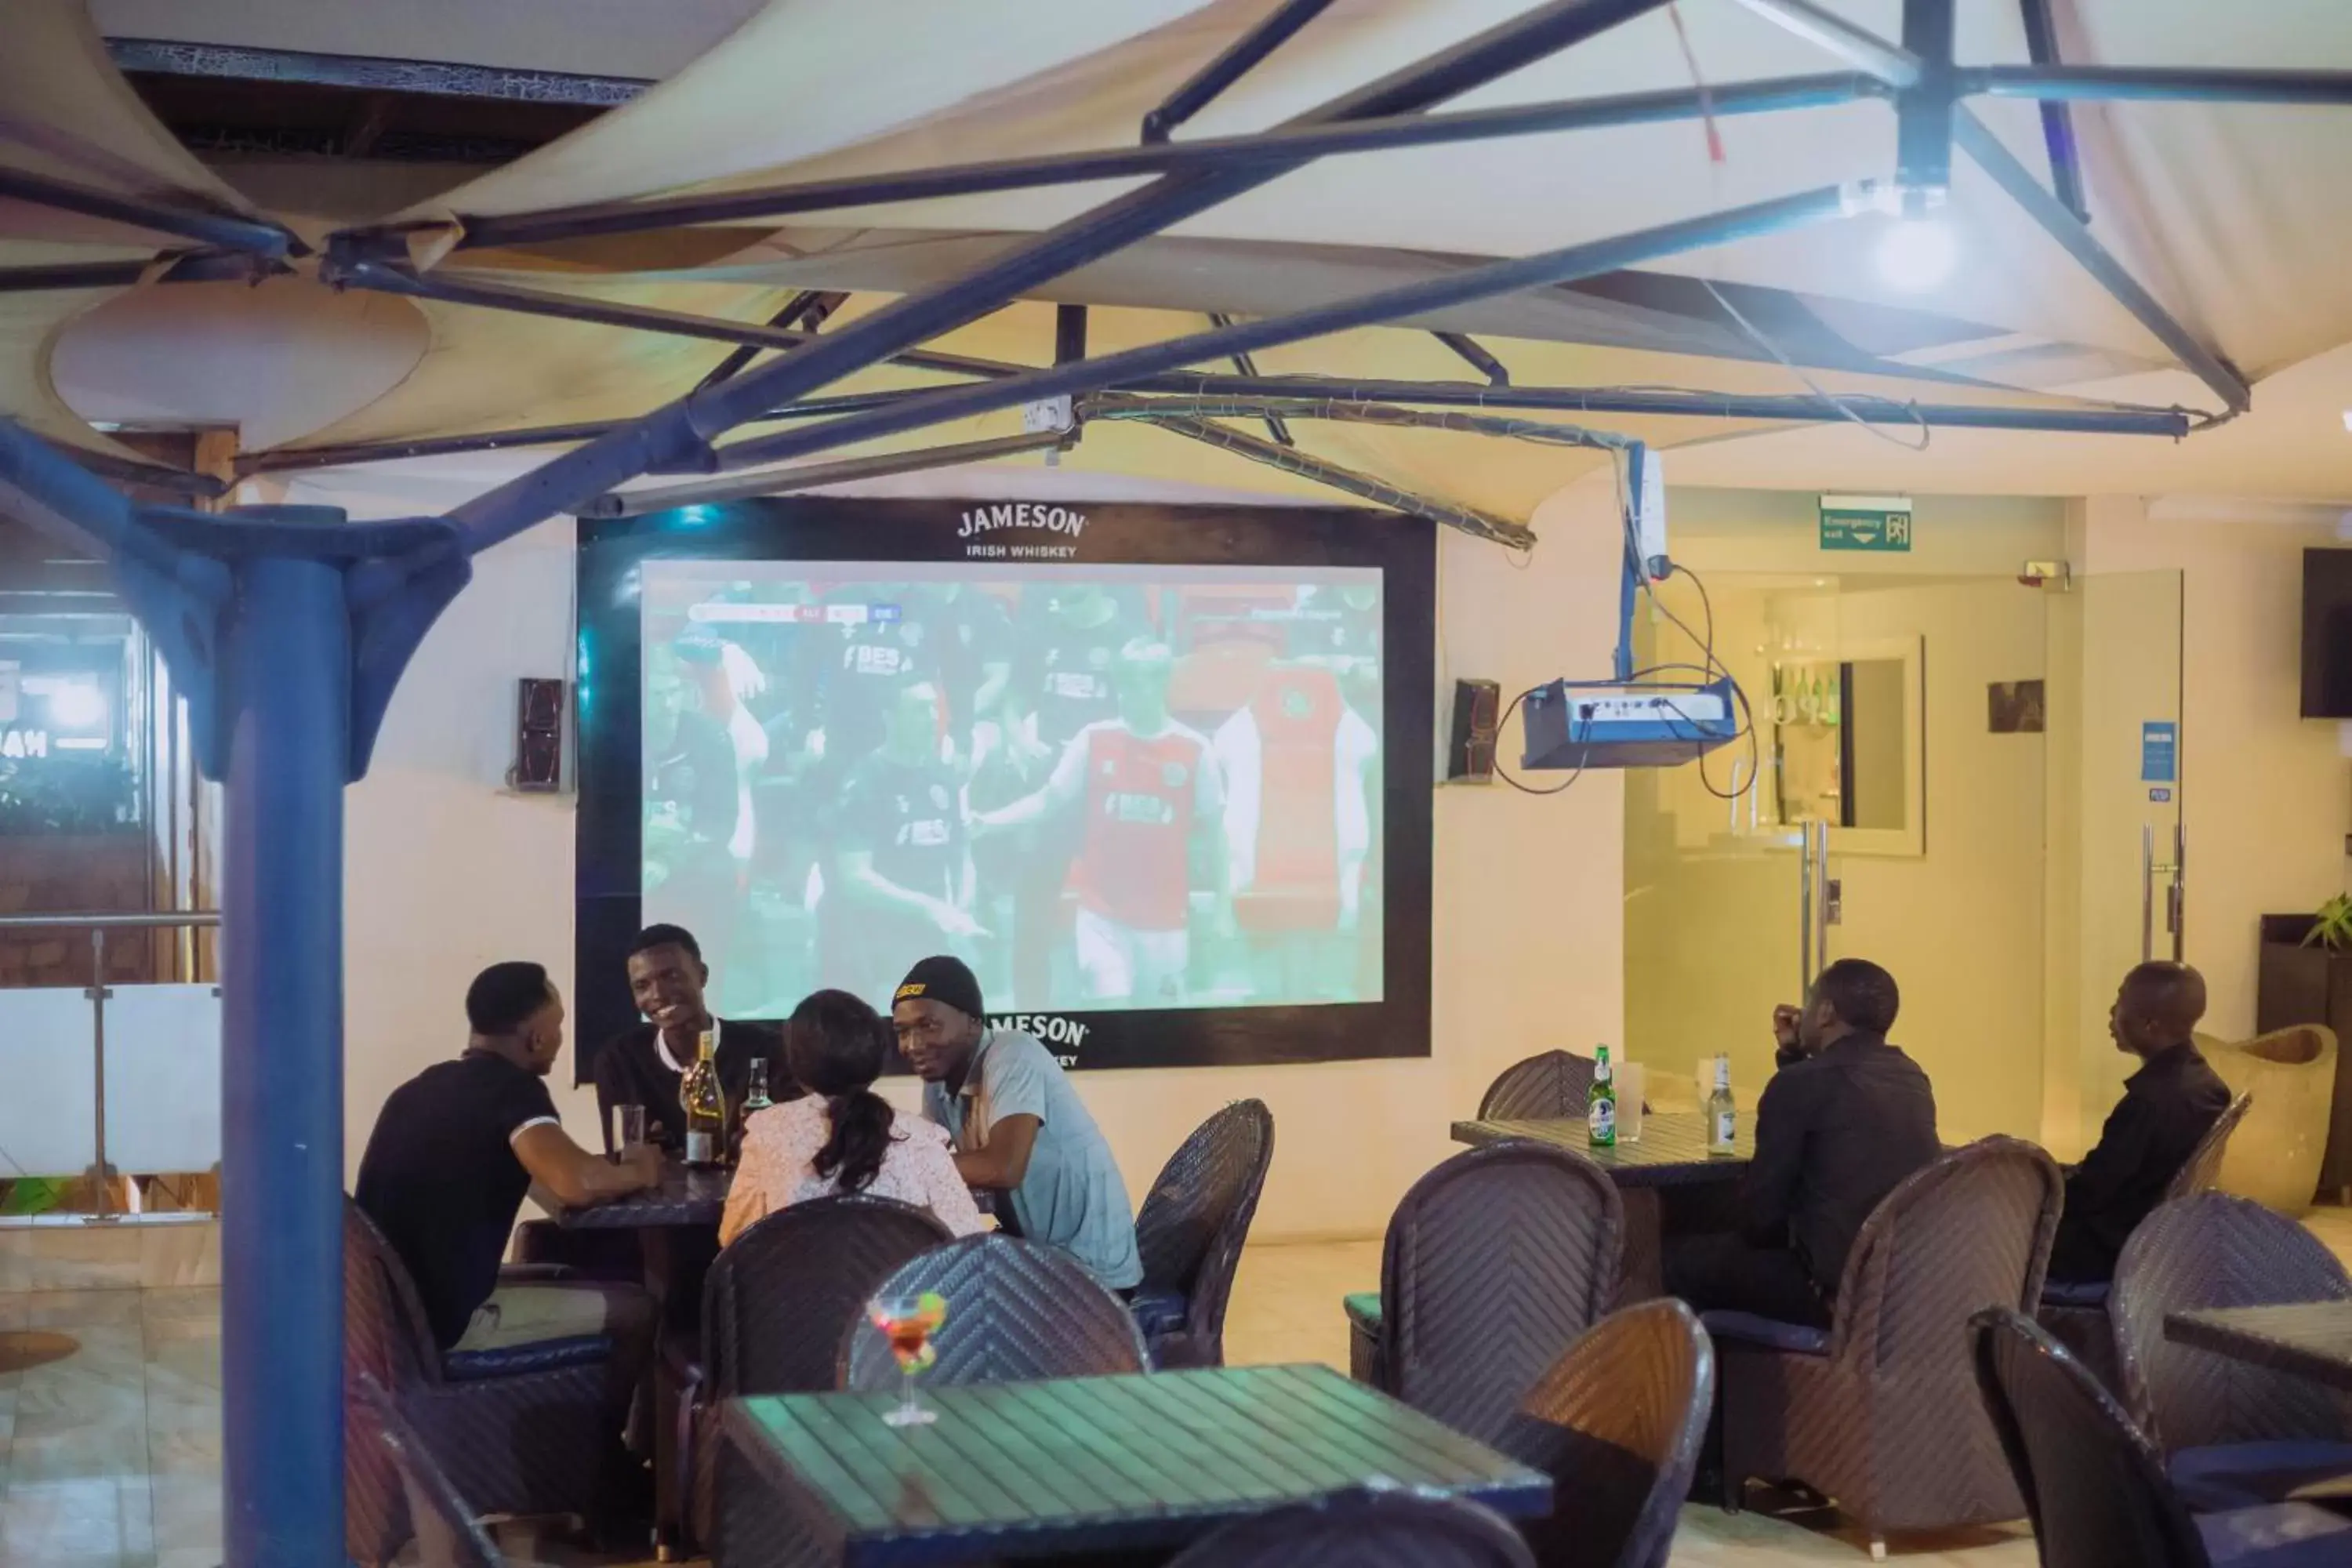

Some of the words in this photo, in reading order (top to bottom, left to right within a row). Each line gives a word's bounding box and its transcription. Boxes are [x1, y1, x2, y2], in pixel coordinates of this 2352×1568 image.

[956, 503, 1086, 538] JAMESON
[966, 545, 1007, 557] IRISH
[1011, 546, 1077, 557] WHISKEY
